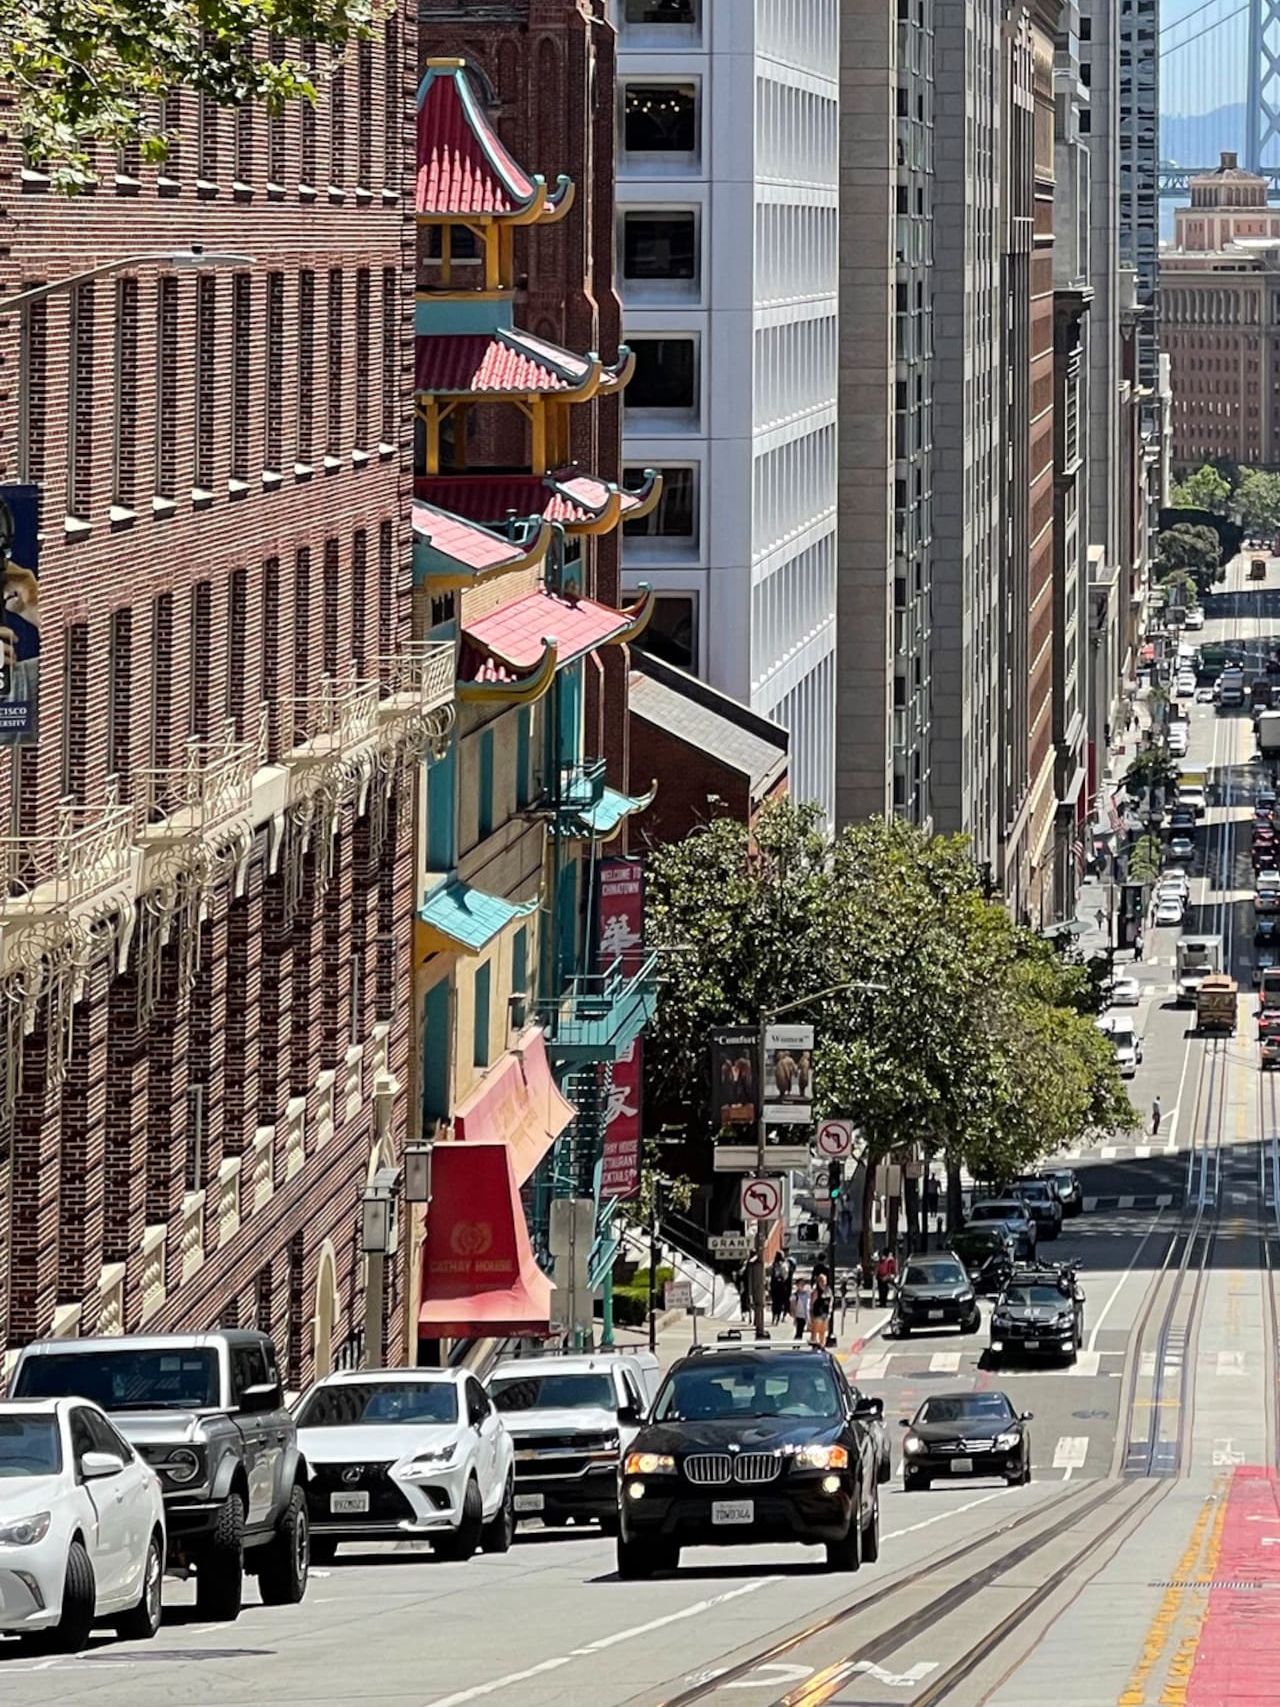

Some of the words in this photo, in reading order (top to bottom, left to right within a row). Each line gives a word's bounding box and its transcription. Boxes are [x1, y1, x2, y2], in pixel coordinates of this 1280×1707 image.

[601, 868, 631, 882] WELCOME
[602, 881, 640, 896] CHINATOWN
[603, 1154, 638, 1170] STAURANT
[603, 1170, 629, 1184] CKTAILS
[711, 1239, 751, 1248] GRANT
